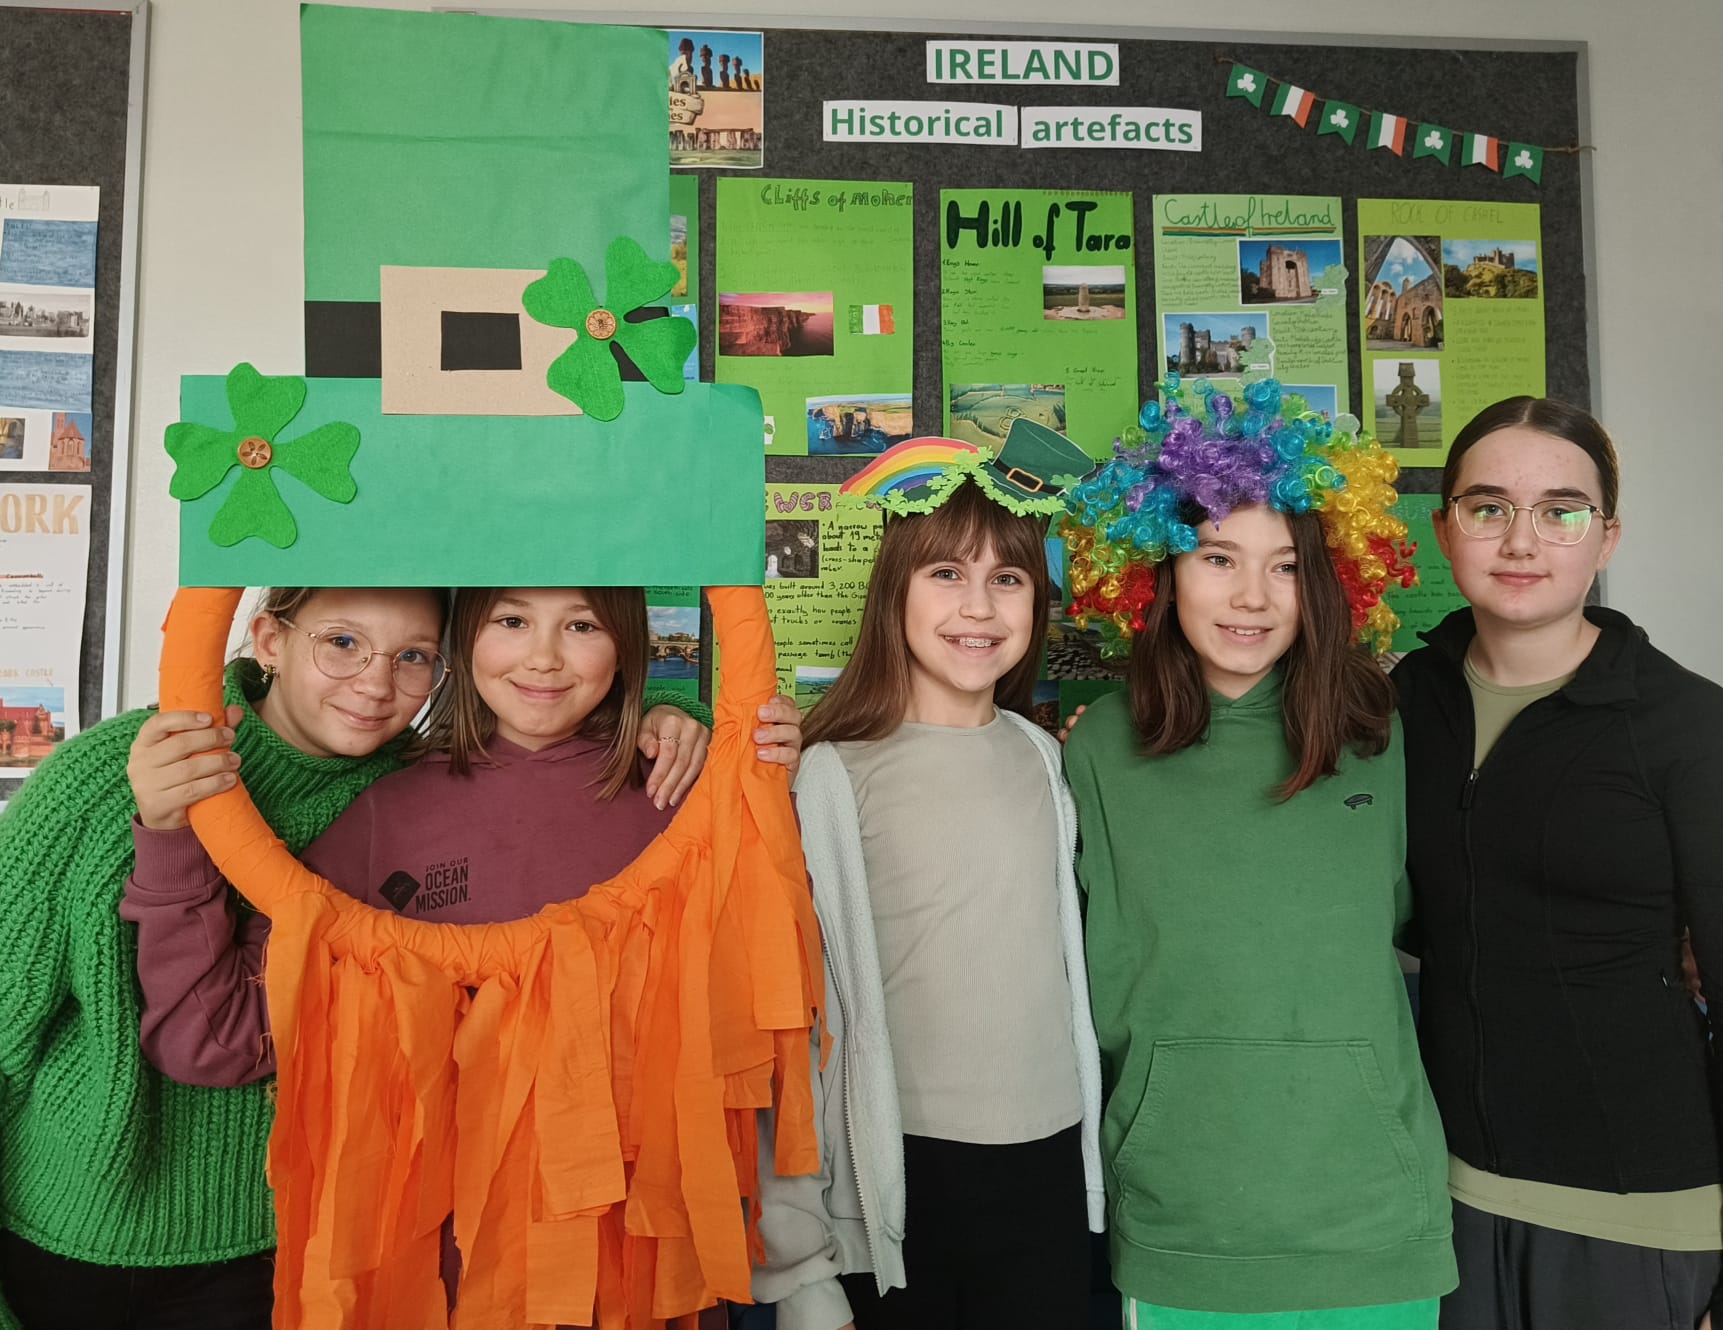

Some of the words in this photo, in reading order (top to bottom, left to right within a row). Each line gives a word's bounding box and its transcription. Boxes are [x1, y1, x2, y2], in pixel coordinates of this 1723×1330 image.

[935, 48, 1114, 81] IRELAND
[831, 108, 1003, 138] Historical
[1032, 114, 1193, 144] artefacts
[827, 191, 846, 212] of
[1261, 199, 1335, 227] Ireland
[1434, 204, 1455, 224] OF
[947, 200, 1022, 249] Hill
[1033, 203, 1060, 261] of
[1065, 201, 1131, 252] Tara
[0, 493, 85, 535] ORK
[822, 531, 845, 540] about
[850, 531, 860, 541] 19
[863, 532, 881, 541] met
[827, 521, 834, 531] A
[838, 524, 867, 532] narrow
[848, 542, 857, 552] to
[779, 581, 796, 590] built
[799, 581, 824, 590] around
[828, 581, 856, 592] 3,200
[776, 604, 809, 616] exactly
[812, 604, 826, 613] how
[782, 615, 809, 625] trucks
[798, 638, 836, 647] sometimes
[840, 636, 853, 646] call
[425, 862, 446, 873] JOIN
[449, 857, 469, 867] OUR
[425, 864, 469, 891] OCEAN
[415, 884, 472, 914] MISSION.
